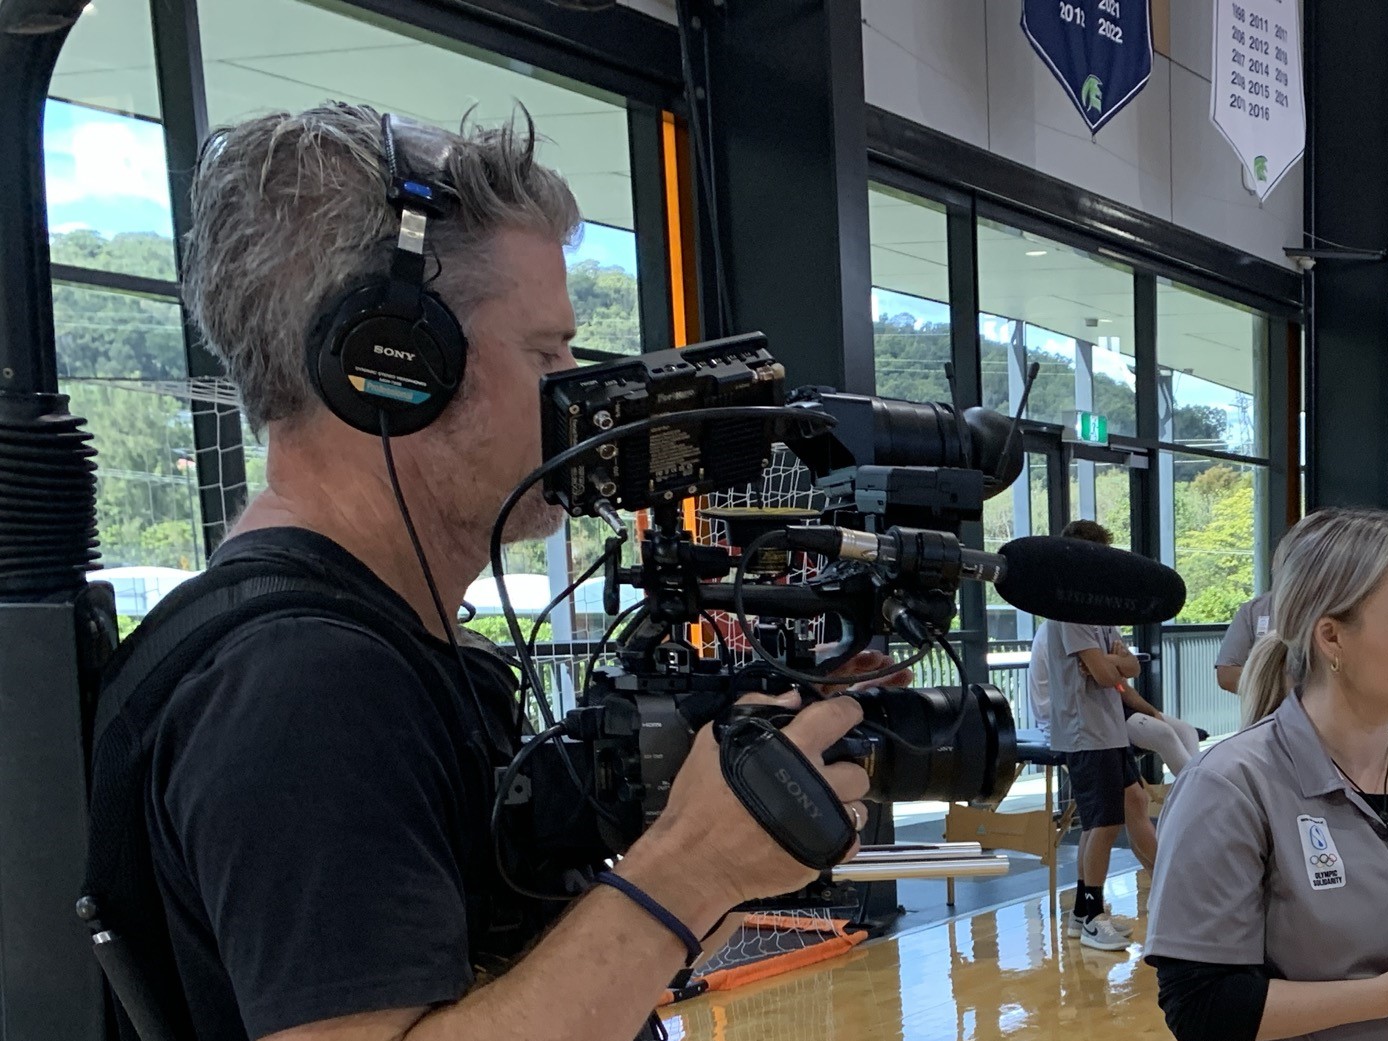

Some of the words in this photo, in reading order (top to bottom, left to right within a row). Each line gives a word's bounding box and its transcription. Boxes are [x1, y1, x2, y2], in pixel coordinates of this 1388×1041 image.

[1249, 13, 1268, 32] 2011
[1249, 36, 1269, 55] 2012
[1249, 58, 1269, 77] 2014
[1248, 80, 1270, 99] 2015
[1248, 103, 1270, 121] 2016
[373, 344, 416, 361] SONY
[774, 768, 823, 819] SONY
[1313, 877, 1342, 886] SOLIDARITY
[1315, 870, 1337, 879] OLYMPIC
